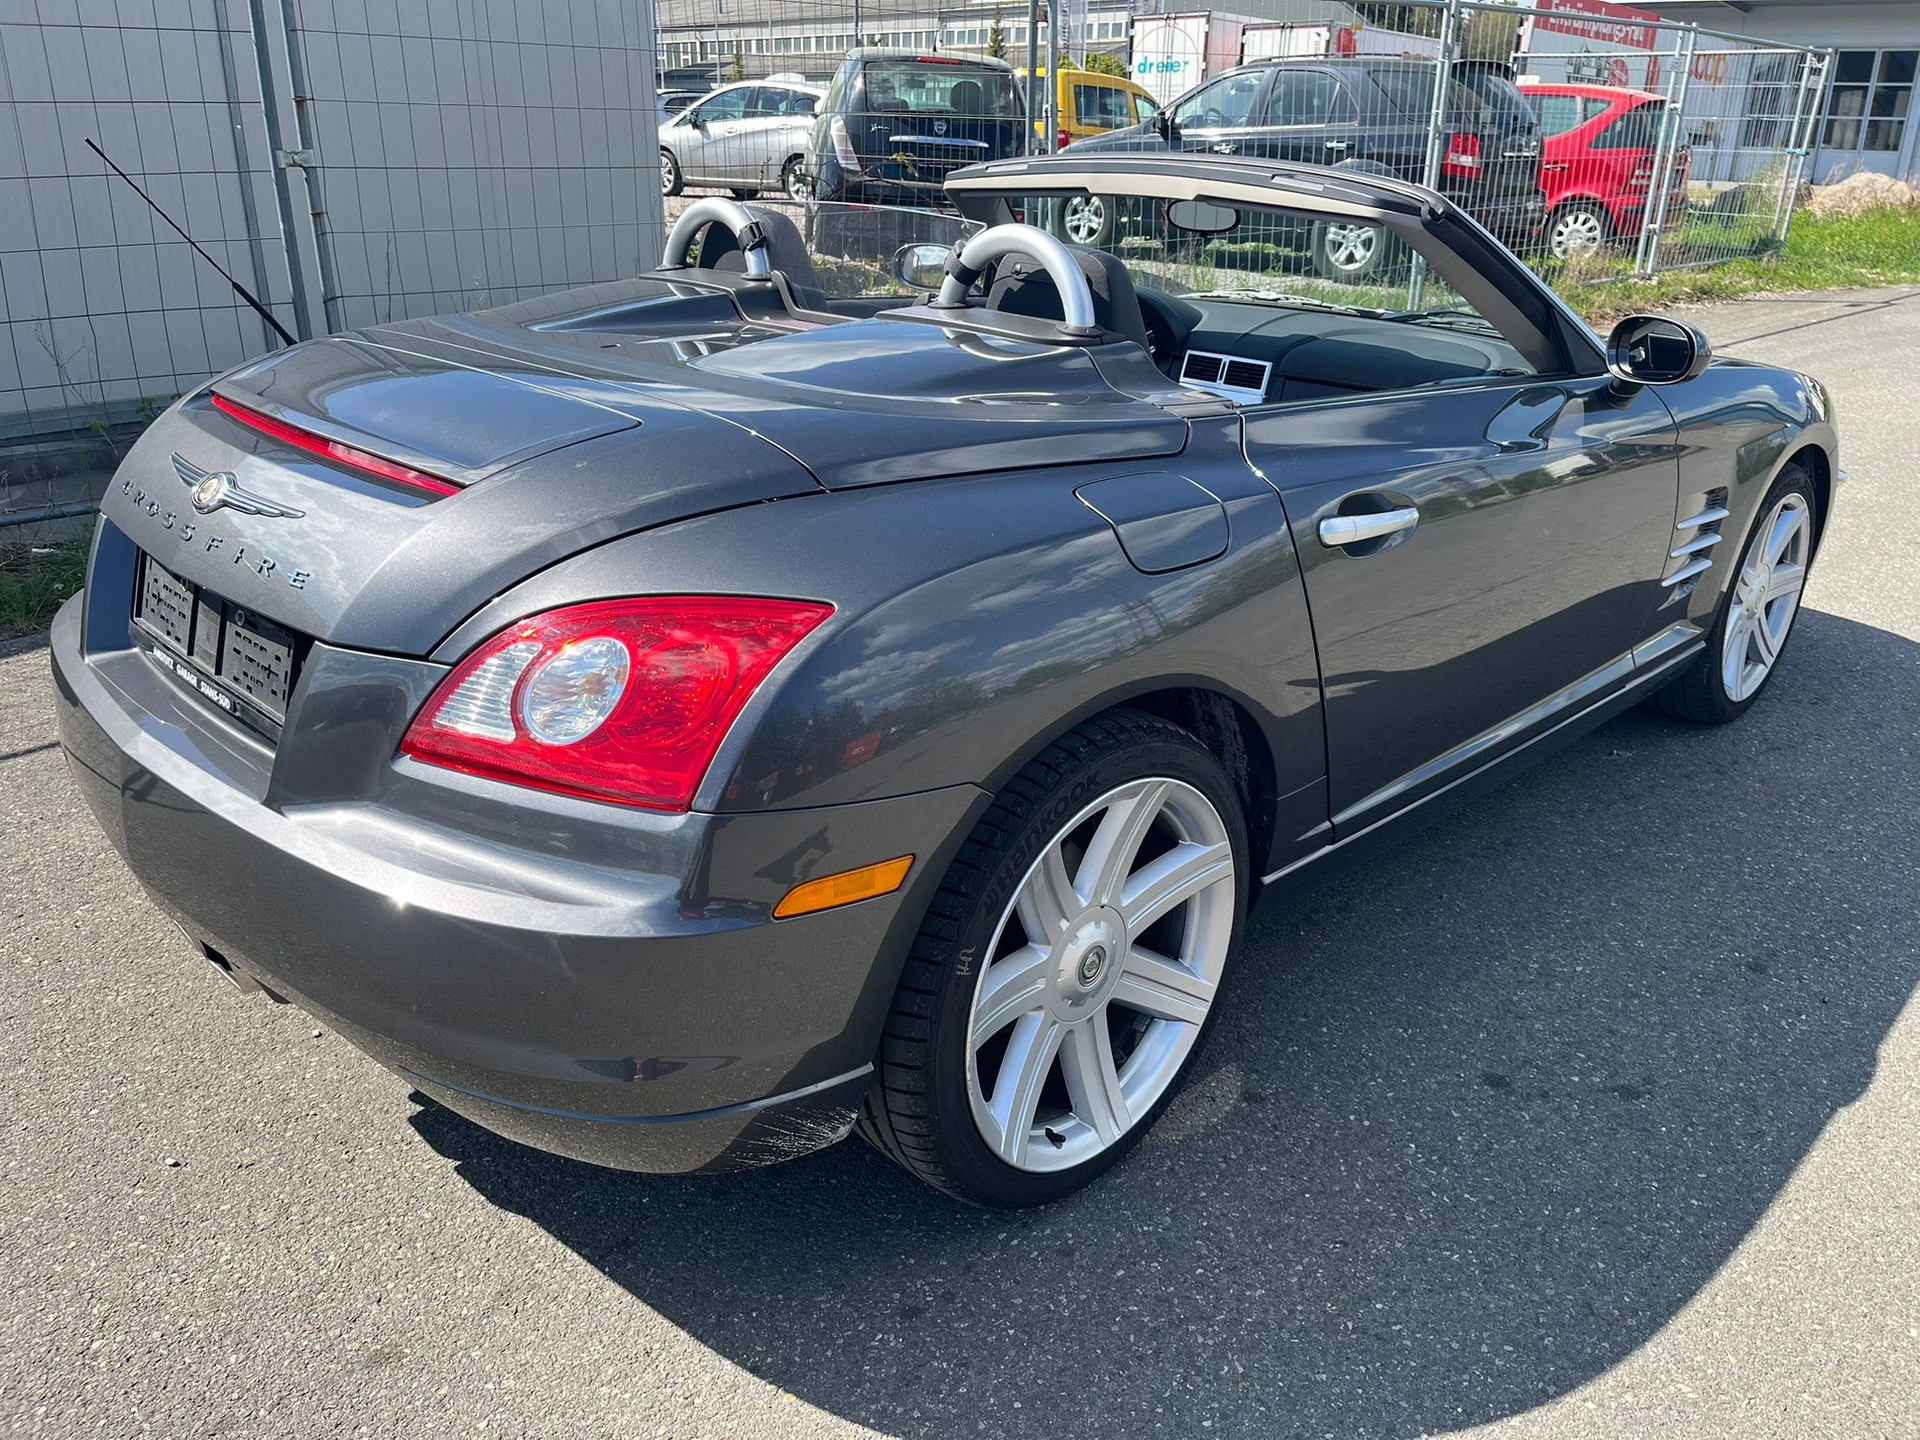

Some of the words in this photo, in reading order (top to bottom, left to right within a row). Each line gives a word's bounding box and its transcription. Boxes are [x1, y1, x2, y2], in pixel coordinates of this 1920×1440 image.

[1138, 54, 1190, 73] dreier
[121, 480, 312, 590] CROSSFIRE
[176, 664, 198, 688] GARAGE
